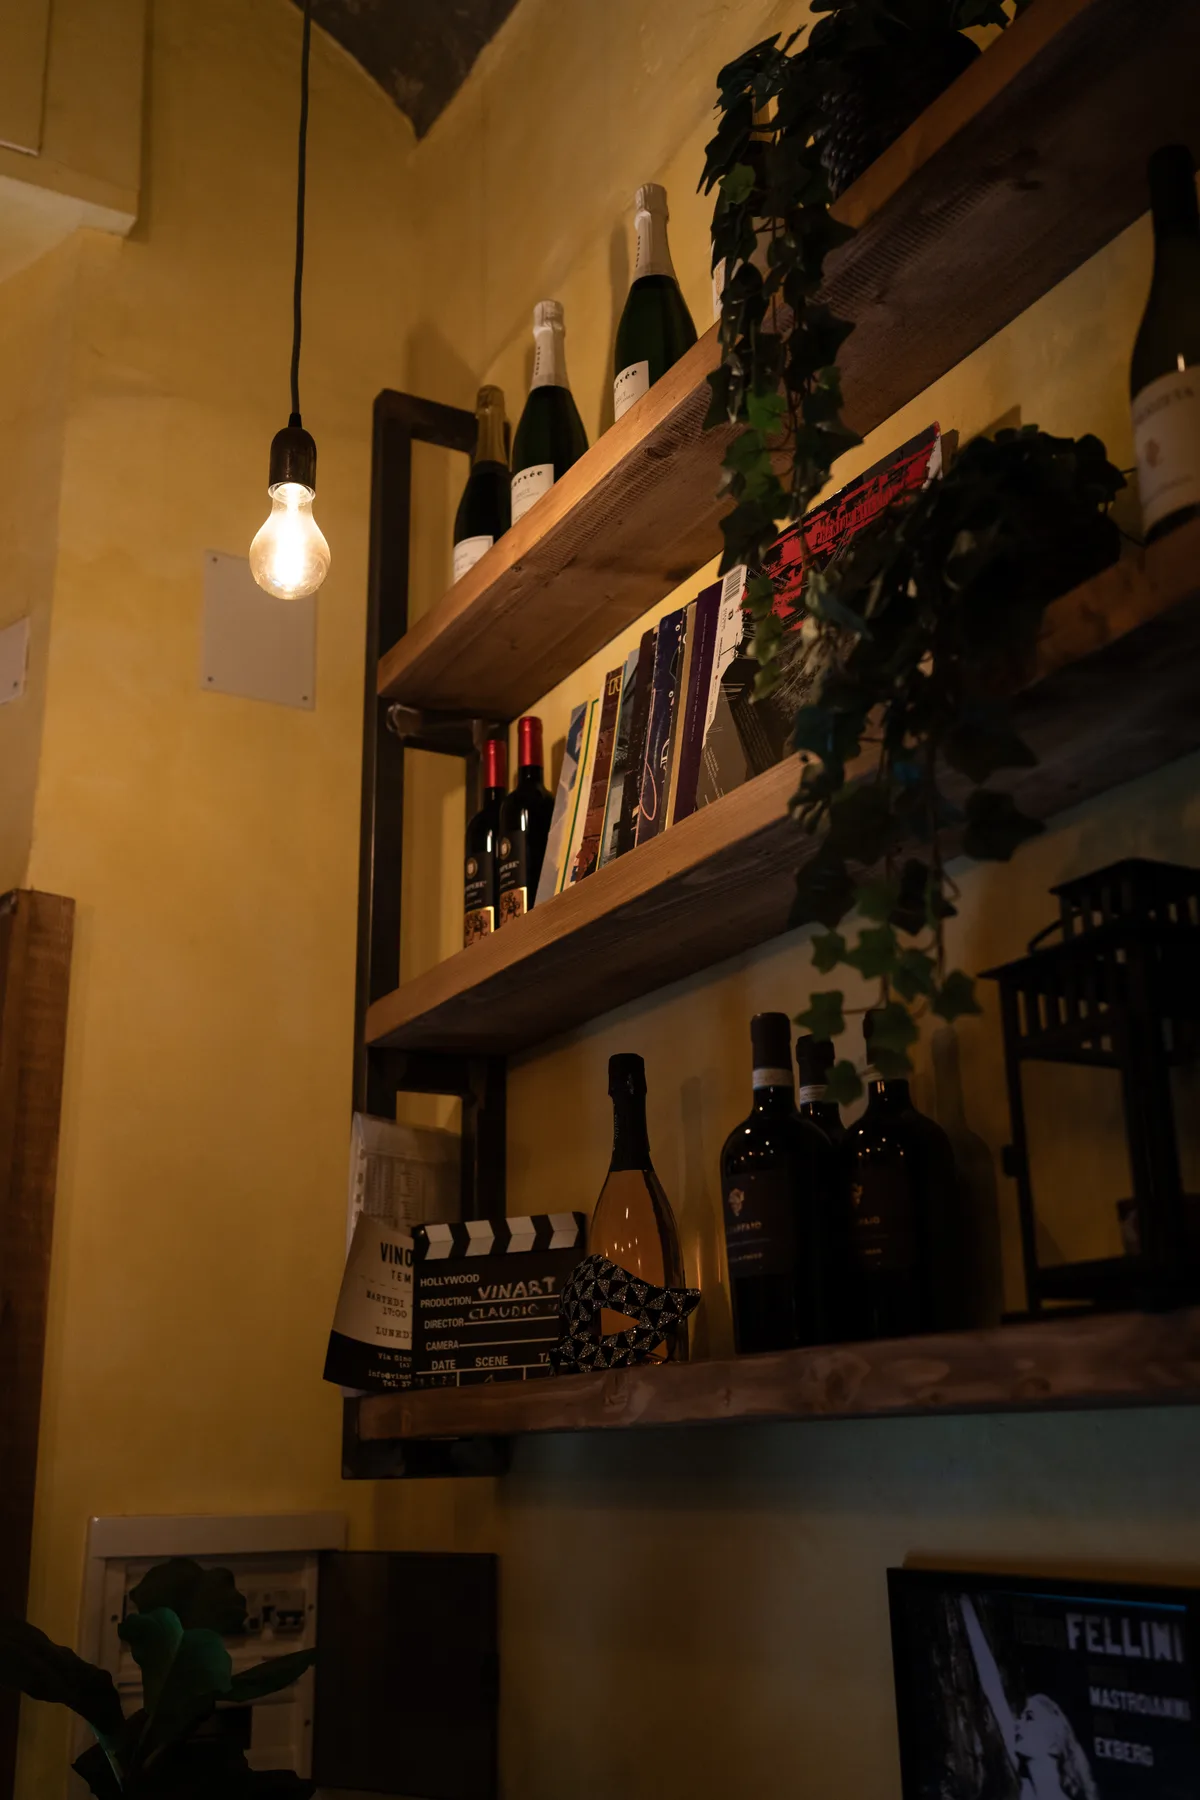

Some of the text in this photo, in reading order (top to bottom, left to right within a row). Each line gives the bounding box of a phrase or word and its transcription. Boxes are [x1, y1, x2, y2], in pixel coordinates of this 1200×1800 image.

[380, 1242, 413, 1268] VINO
[420, 1273, 480, 1288] HOLLYWOOD
[477, 1276, 556, 1300] VINART
[420, 1296, 472, 1308] PRODUCTION
[424, 1317, 465, 1330] DIRECTOR
[425, 1340, 459, 1352] CAMERA
[431, 1359, 457, 1371] DATE
[475, 1355, 509, 1367] SCENE
[1065, 1612, 1185, 1664] FELLINI
